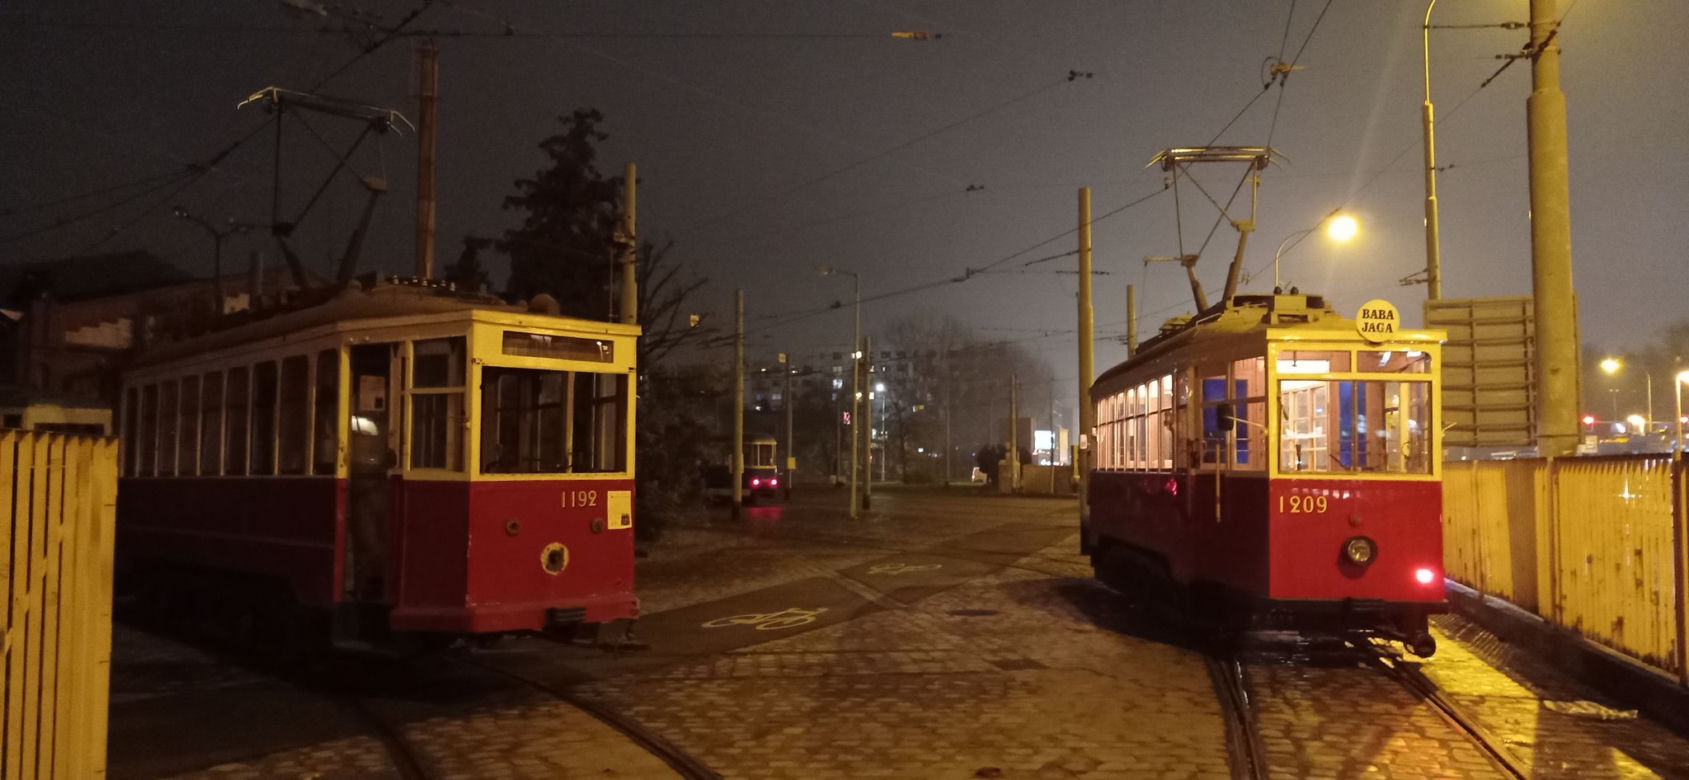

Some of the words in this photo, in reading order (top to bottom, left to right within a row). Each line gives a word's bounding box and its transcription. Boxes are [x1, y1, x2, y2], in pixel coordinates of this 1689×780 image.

[1362, 309, 1394, 320] BABA
[1361, 322, 1393, 333] JAGA
[561, 490, 597, 508] 1192
[1279, 495, 1328, 513] 1209
